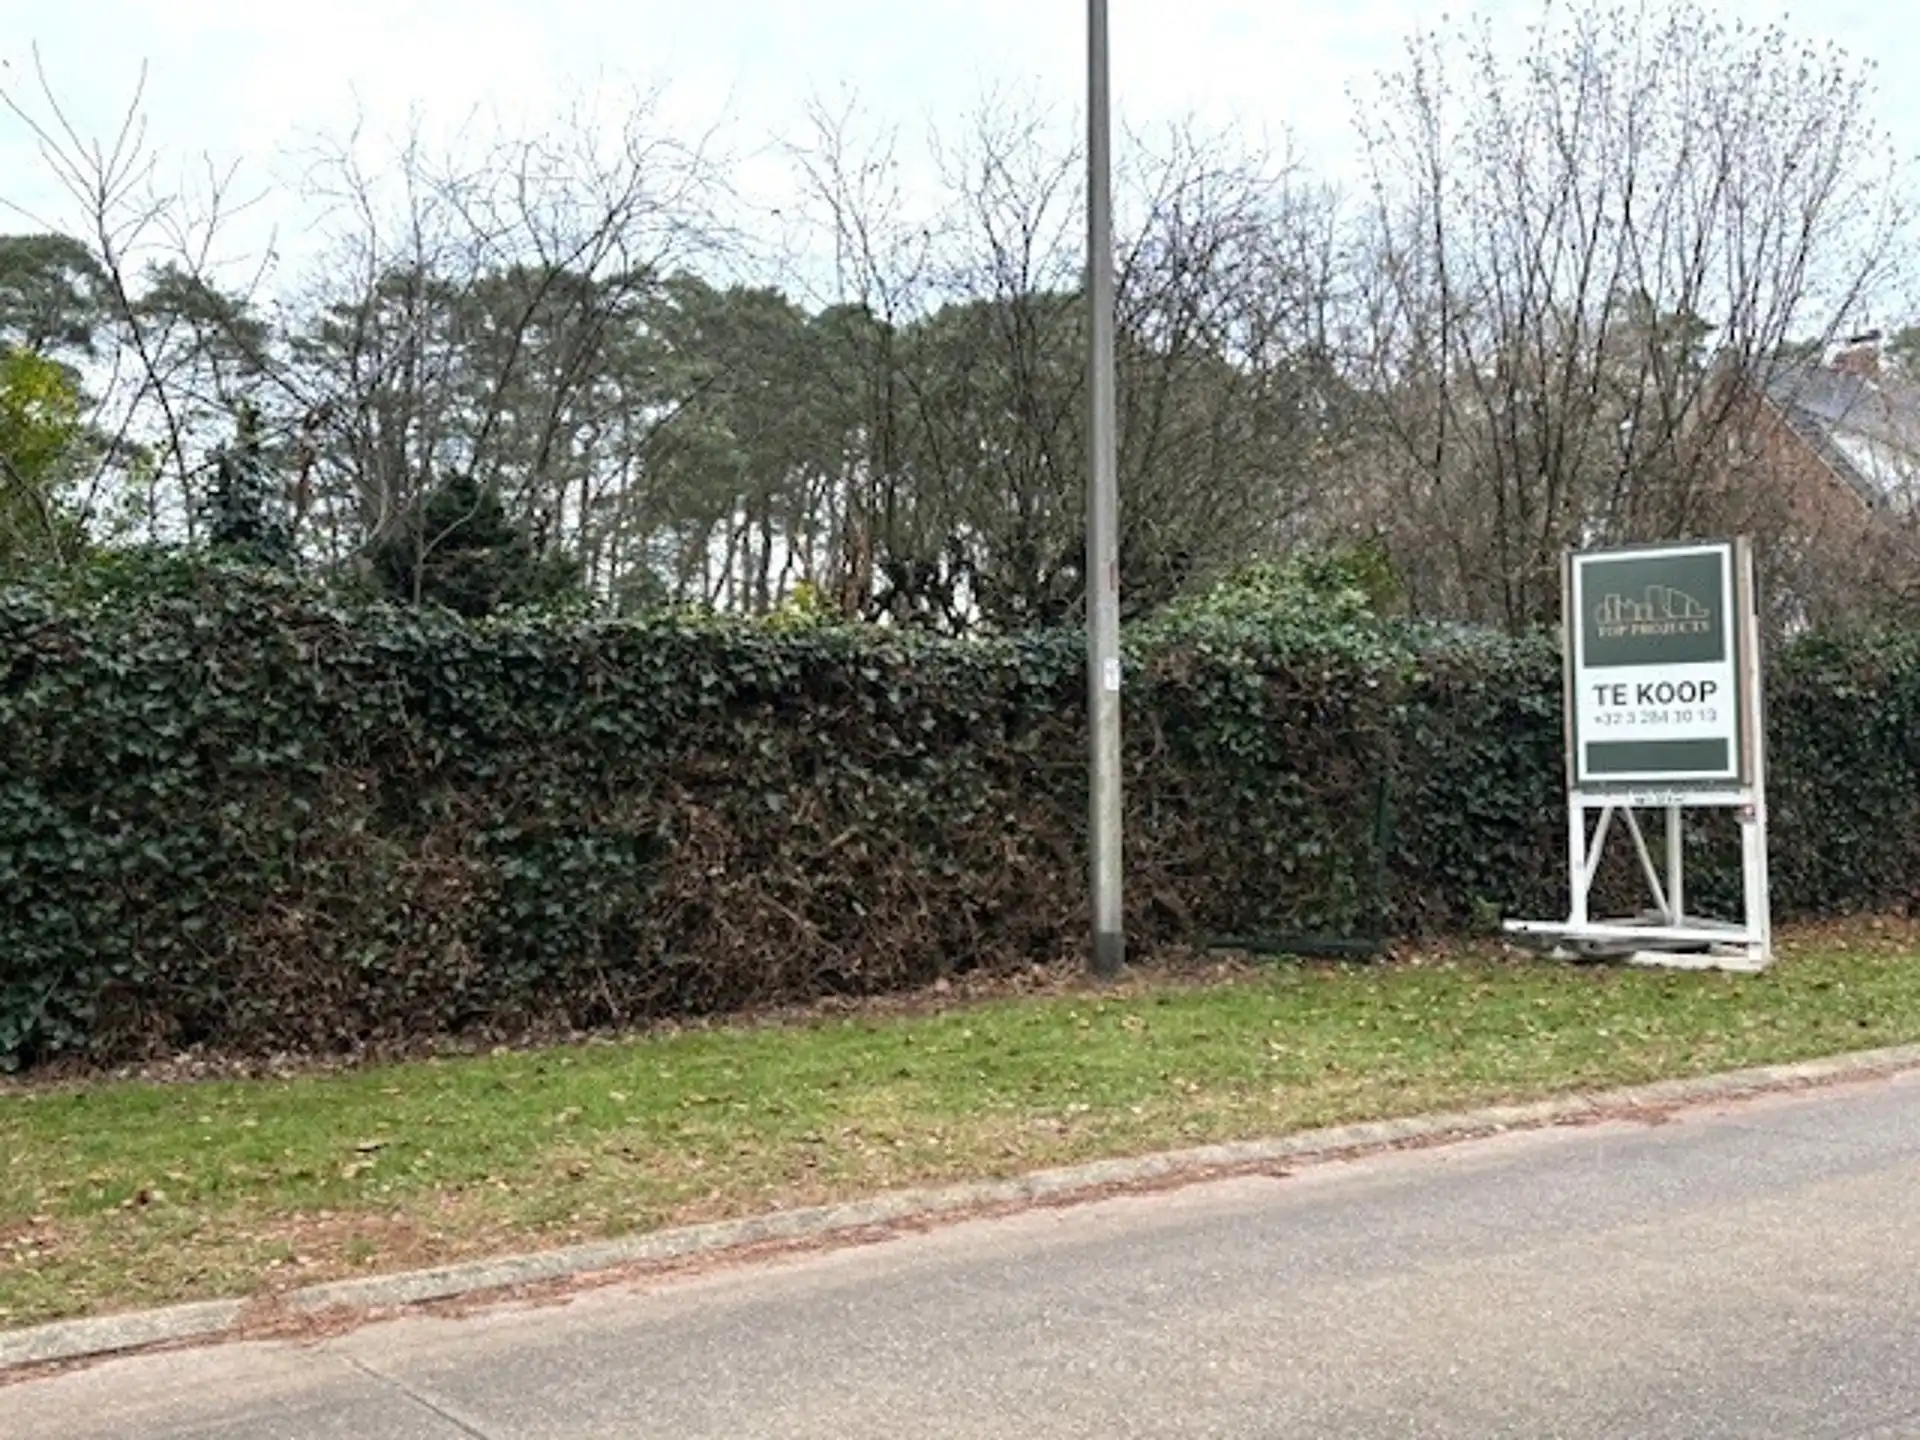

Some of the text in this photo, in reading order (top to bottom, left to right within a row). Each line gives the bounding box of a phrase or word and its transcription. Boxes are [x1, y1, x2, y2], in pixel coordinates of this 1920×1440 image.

[1593, 680, 1717, 706] TE KOOP
[1593, 711, 1623, 726] +32
